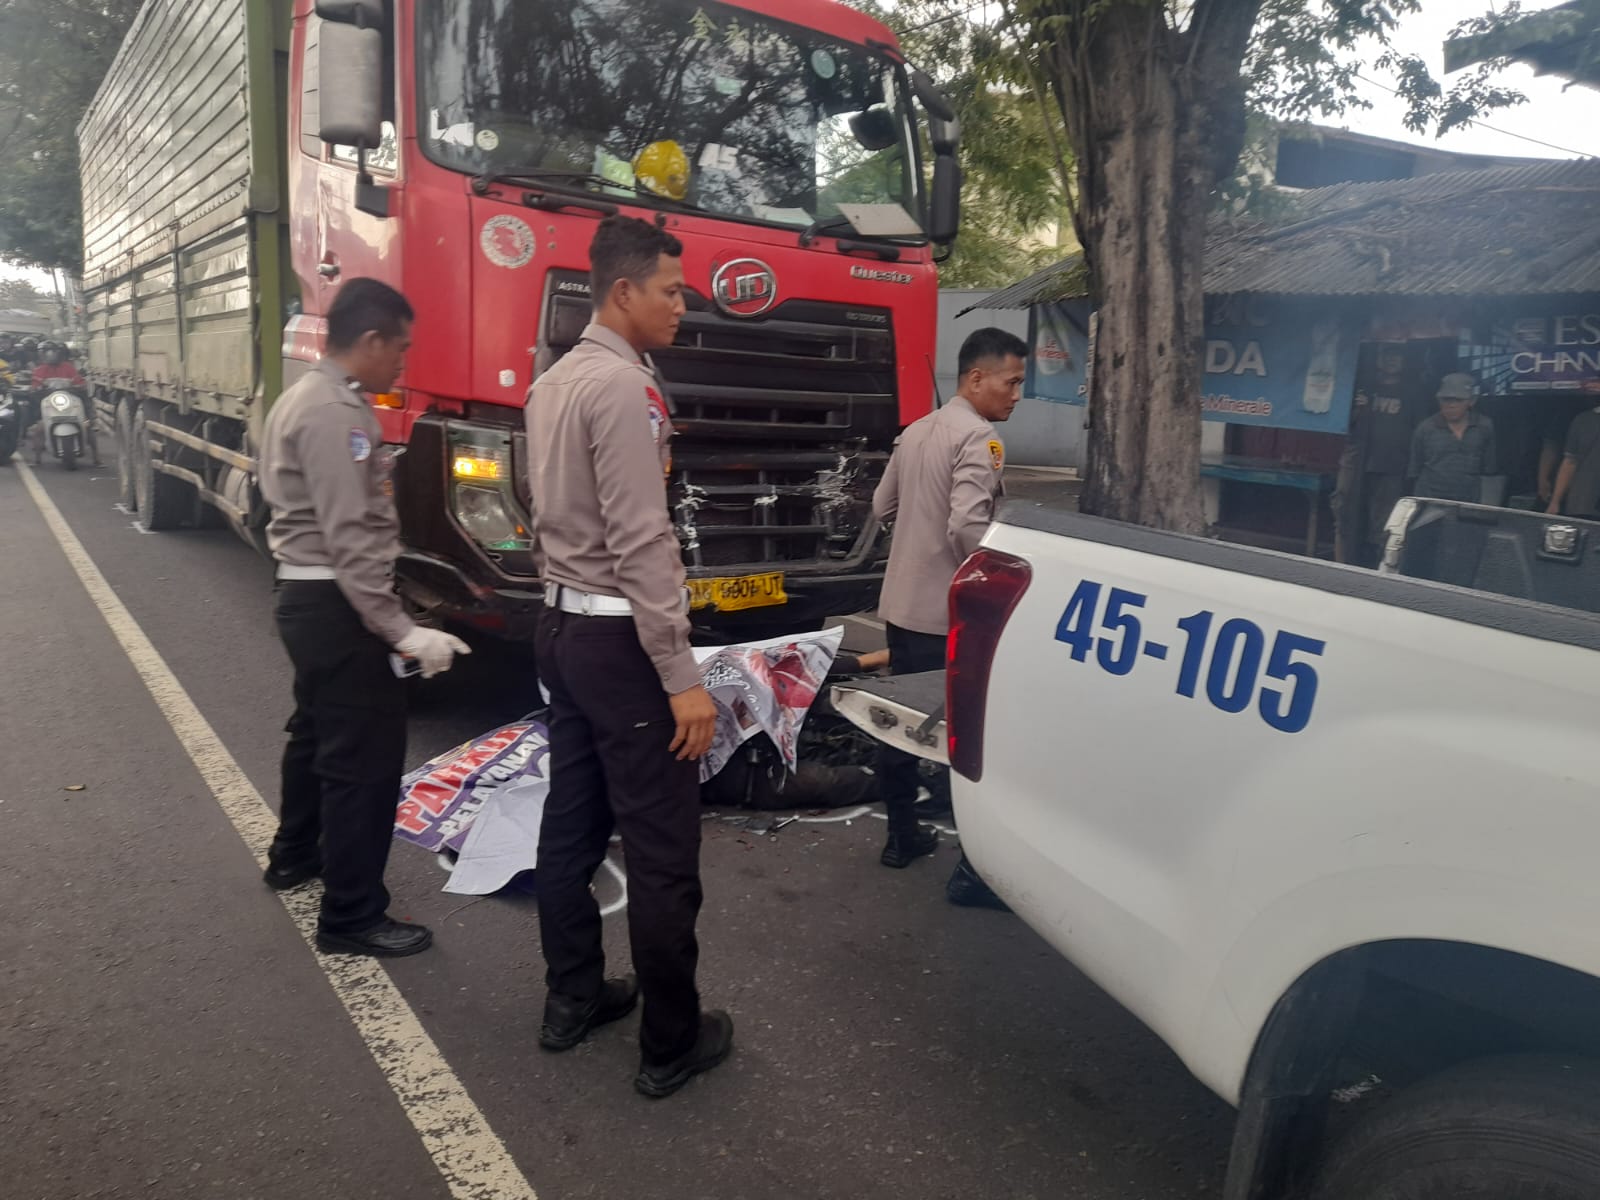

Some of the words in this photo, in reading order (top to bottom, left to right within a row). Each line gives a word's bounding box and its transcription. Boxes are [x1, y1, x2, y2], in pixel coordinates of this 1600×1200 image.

[718, 271, 769, 305] UD
[850, 264, 913, 285] Quester
[1204, 339, 1267, 377] DA
[1206, 393, 1272, 417] Minerale
[1054, 578, 1327, 734] 45-105
